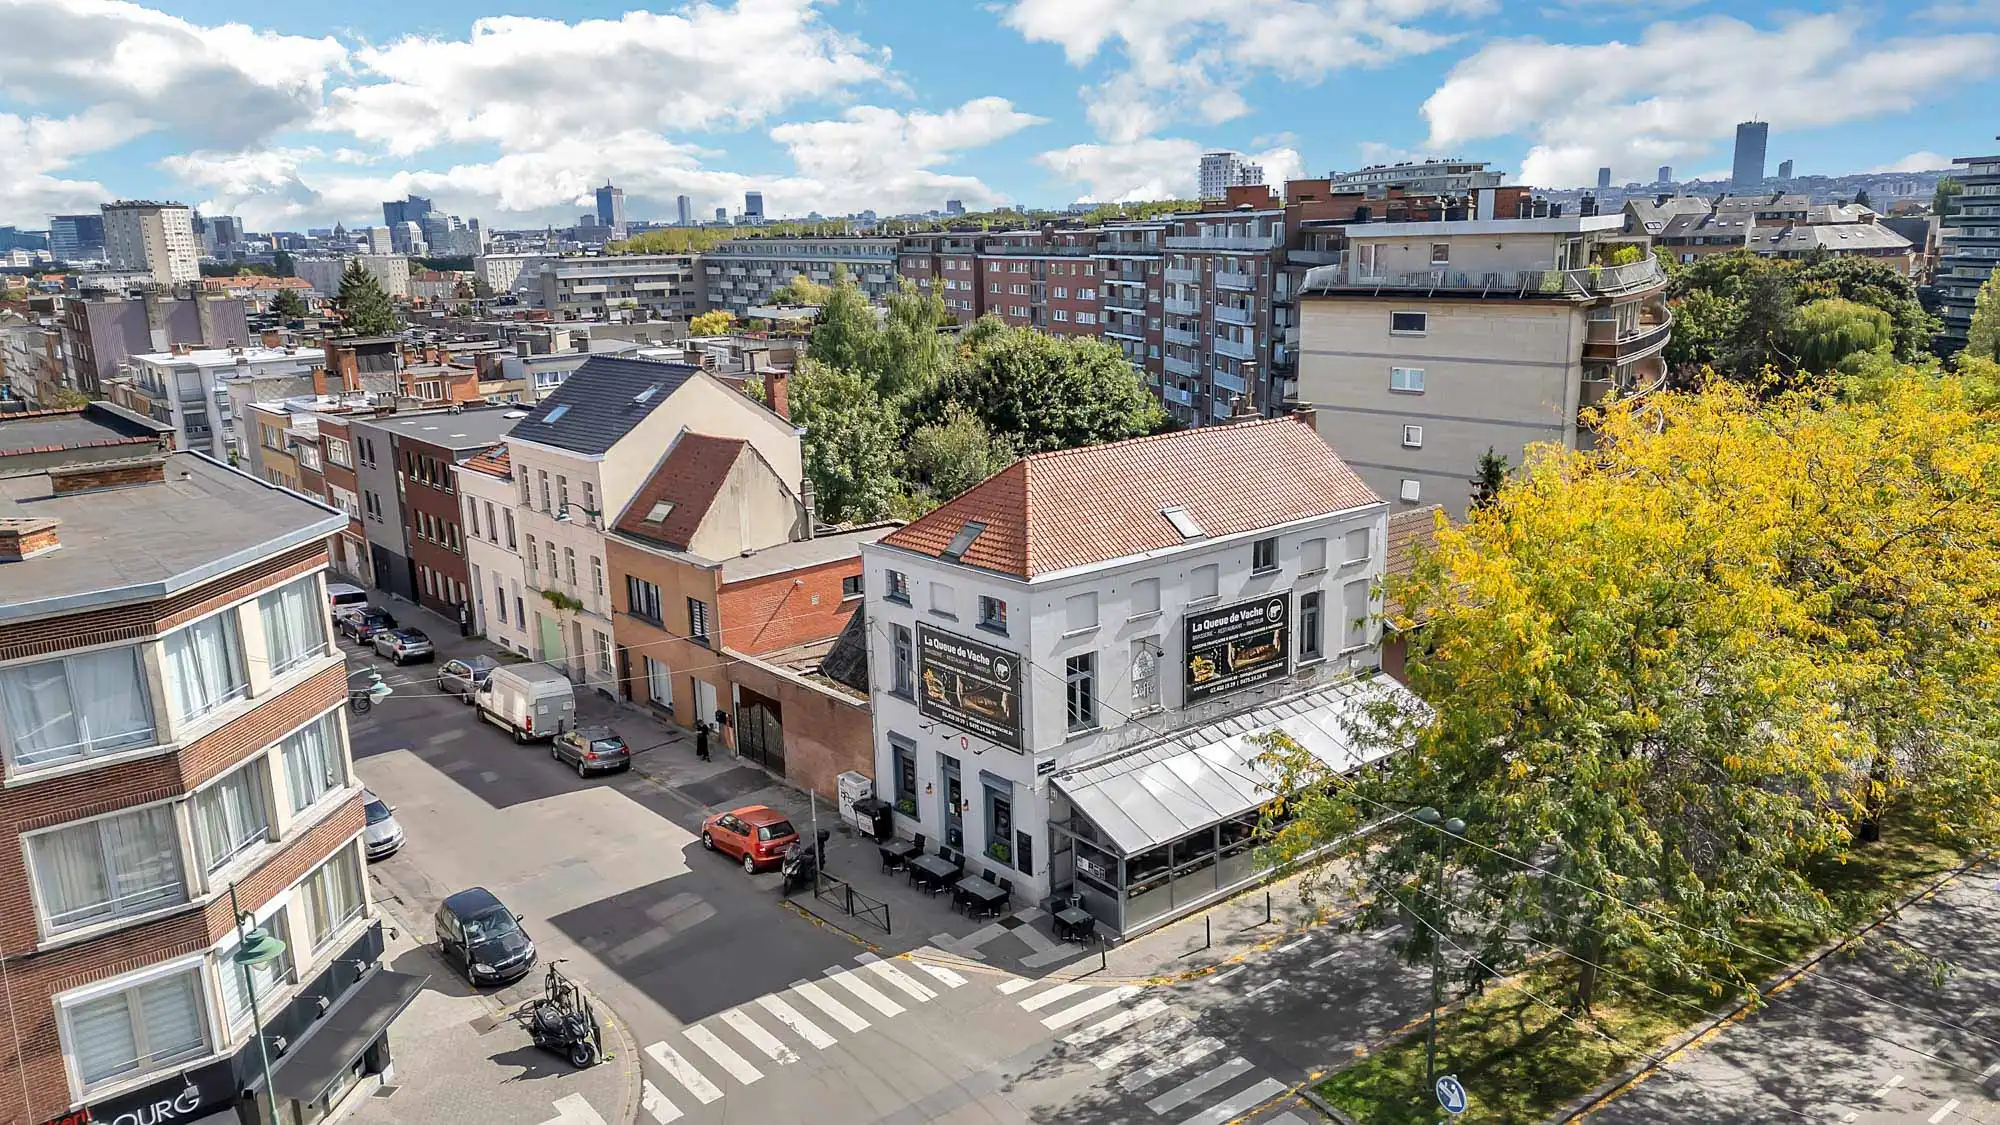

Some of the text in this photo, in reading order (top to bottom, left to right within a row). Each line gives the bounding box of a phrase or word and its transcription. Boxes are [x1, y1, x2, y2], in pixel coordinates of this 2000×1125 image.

[1192, 606, 1264, 632] La Queue de Vache
[924, 635, 990, 666] La Queue de Vache
[101, 1093, 200, 1125] OURG
